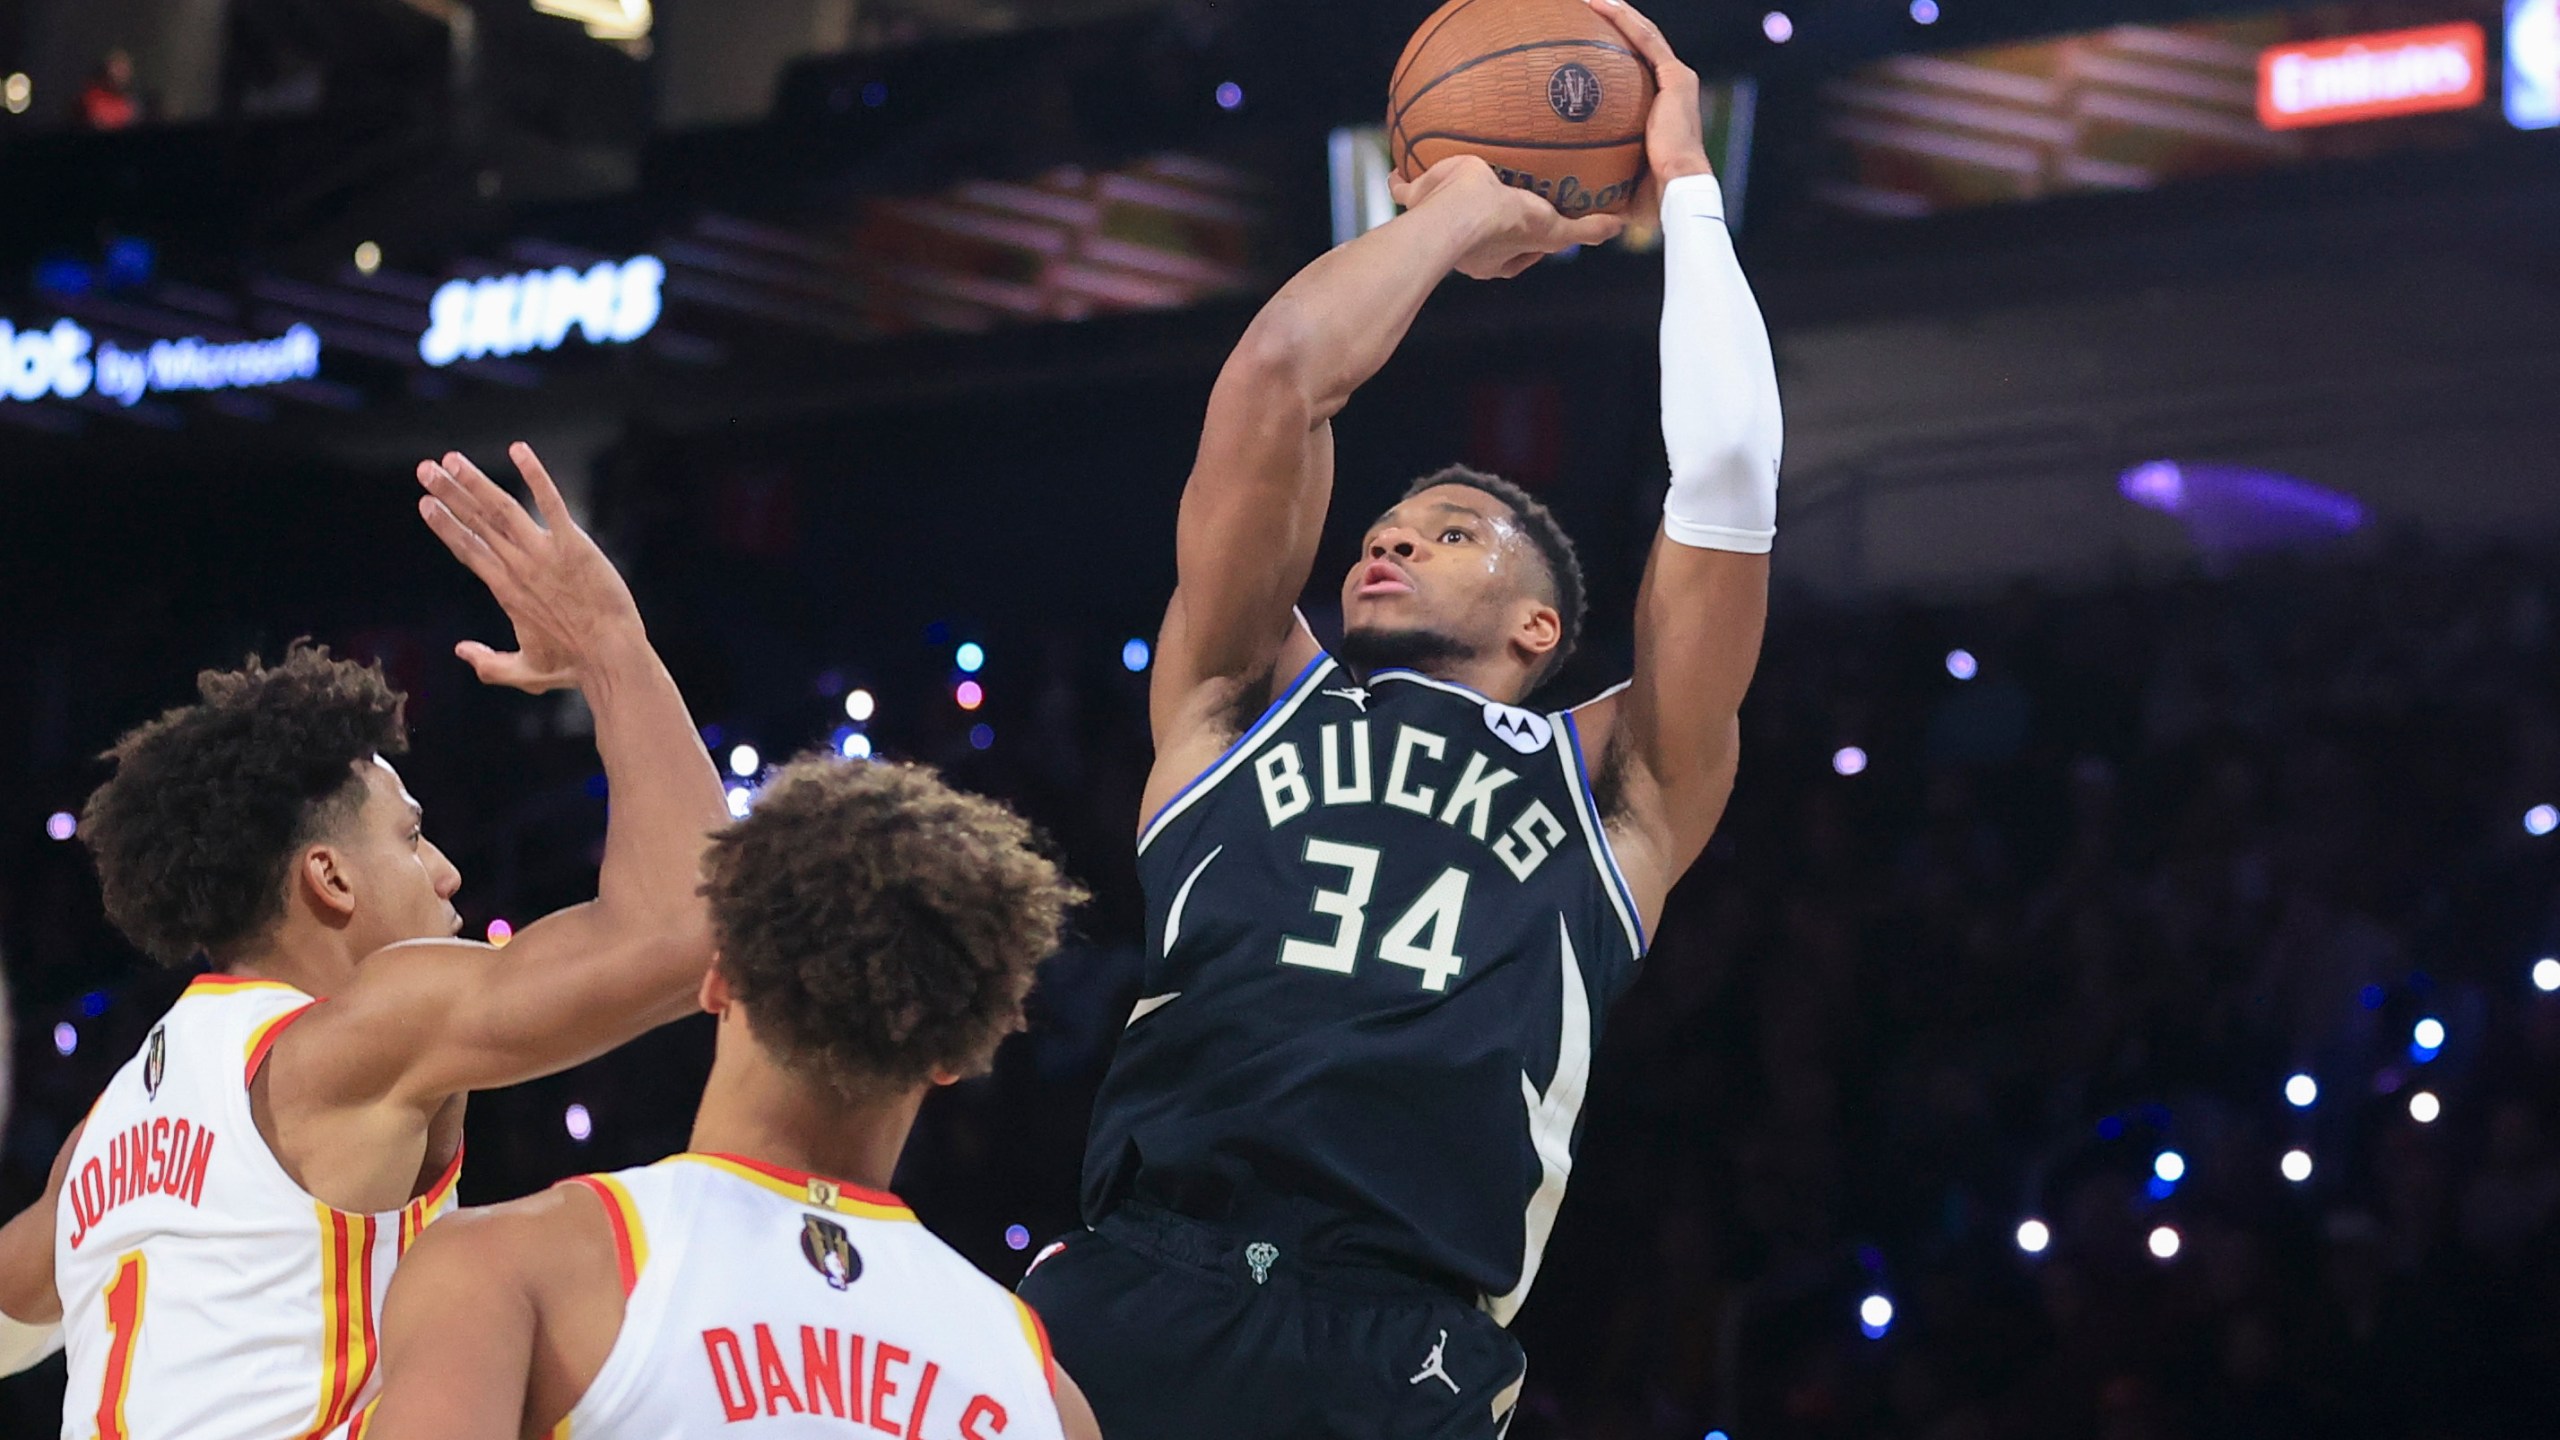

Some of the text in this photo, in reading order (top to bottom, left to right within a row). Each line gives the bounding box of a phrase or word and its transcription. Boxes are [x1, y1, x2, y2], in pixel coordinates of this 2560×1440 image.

[2272, 44, 2471, 114] Emirates
[96, 342, 148, 407] by
[147, 322, 320, 392] Microsoft
[419, 255, 665, 366] SKIMS
[1254, 719, 1568, 884] BUCKS
[1276, 835, 1475, 994] 34
[70, 1116, 215, 1250] JOHNSON
[91, 1248, 148, 1440] 1
